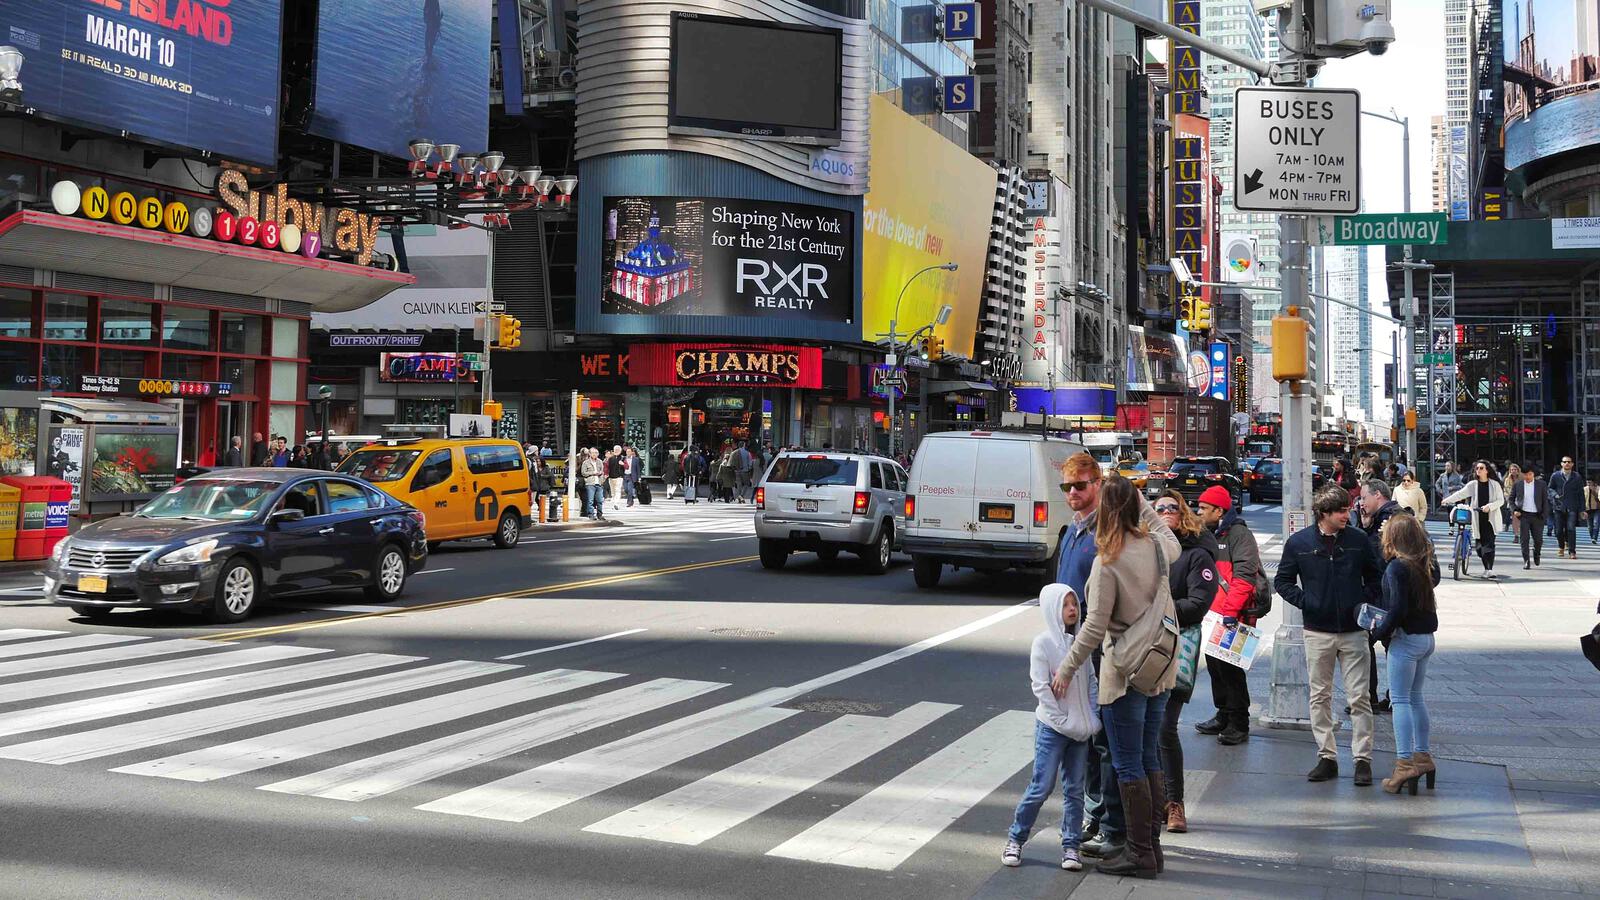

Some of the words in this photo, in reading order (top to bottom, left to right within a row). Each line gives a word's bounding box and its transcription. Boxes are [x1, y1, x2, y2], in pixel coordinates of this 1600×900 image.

[952, 10, 968, 31] P
[86, 14, 151, 61] MARCH
[157, 37, 175, 67] 10
[61, 48, 72, 60] SEE
[73, 51, 78, 61] IT
[79, 54, 86, 65] IN
[123, 66, 137, 78] 3D
[150, 74, 176, 90] IMAX
[178, 82, 192, 94] 3D
[952, 82, 966, 104] S
[1260, 99, 1334, 120] BUSES
[741, 127, 773, 135] SHARP
[1268, 126, 1325, 146] ONLY
[812, 157, 854, 177] AQUOS
[1276, 153, 1302, 165] 7AM
[1313, 154, 1345, 166] 10AM
[1279, 171, 1305, 183] 4PM
[1316, 172, 1341, 184] 7PM
[91, 191, 105, 213] N
[1269, 188, 1299, 200] MON
[1302, 192, 1327, 201] THRU
[1329, 190, 1351, 202] FRI
[120, 197, 132, 219] Q
[147, 202, 158, 223] R
[218, 169, 382, 266] Subway
[172, 208, 187, 230] W
[198, 211, 209, 233] S
[223, 216, 231, 236] 1
[712, 206, 777, 231] Shaping
[781, 212, 813, 230] New
[816, 215, 841, 234] York
[245, 220, 255, 241] 2
[266, 224, 276, 244] 3
[878, 208, 894, 239] the
[895, 214, 915, 247] love
[915, 223, 928, 251] of
[925, 232, 944, 257] new
[1341, 217, 1440, 245] Broadway
[310, 236, 318, 254] 7
[711, 230, 735, 247] for
[740, 232, 764, 249] the
[768, 235, 796, 252] 21st
[799, 237, 845, 260] Century
[736, 258, 829, 299] RXR
[1033, 217, 1047, 361] AMSTERDAM
[403, 302, 446, 315] CALVIN
[755, 296, 814, 310] REALTY
[332, 336, 386, 346] OUTFRONT
[391, 336, 420, 345] PRIME
[390, 357, 468, 377] CHAMPS
[581, 354, 610, 376] WE
[675, 351, 800, 381] CHAMPS
[991, 356, 1024, 380] SEPHORA
[81, 384, 101, 392] Subway
[82, 375, 97, 384] Times
[715, 374, 768, 383] SPORTS
[62, 433, 84, 442] CRIME
[922, 485, 955, 495] Peepels
[48, 505, 69, 516] VOICE
[434, 500, 448, 508] NYC
